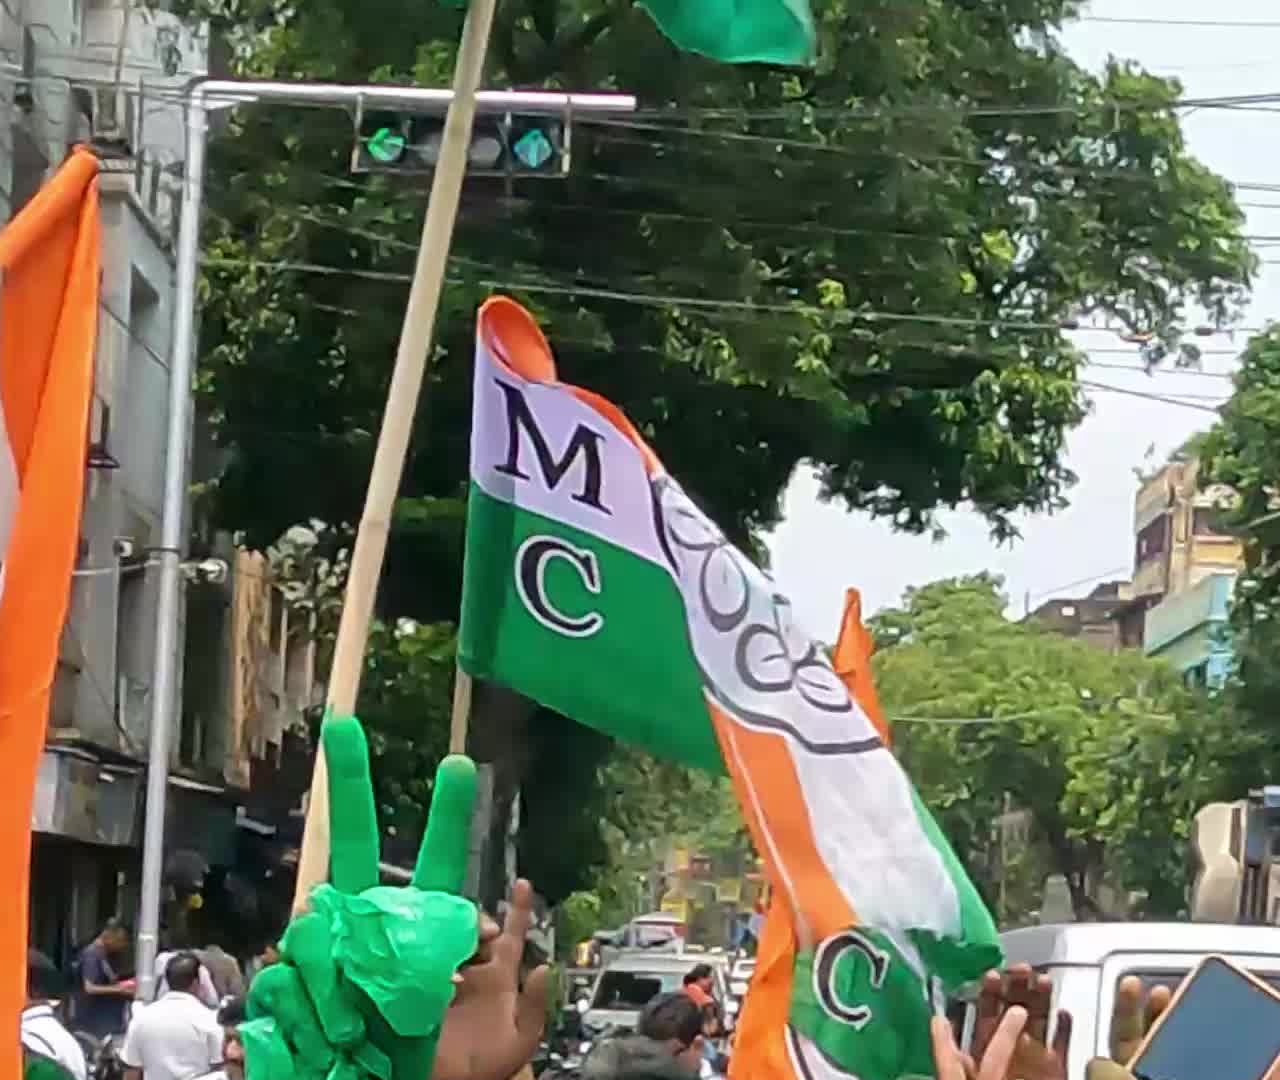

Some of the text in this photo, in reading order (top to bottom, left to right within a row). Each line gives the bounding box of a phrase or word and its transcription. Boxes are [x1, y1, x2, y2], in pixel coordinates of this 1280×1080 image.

[495, 378, 613, 516] M
[515, 534, 603, 637] C
[812, 929, 890, 1030] C
